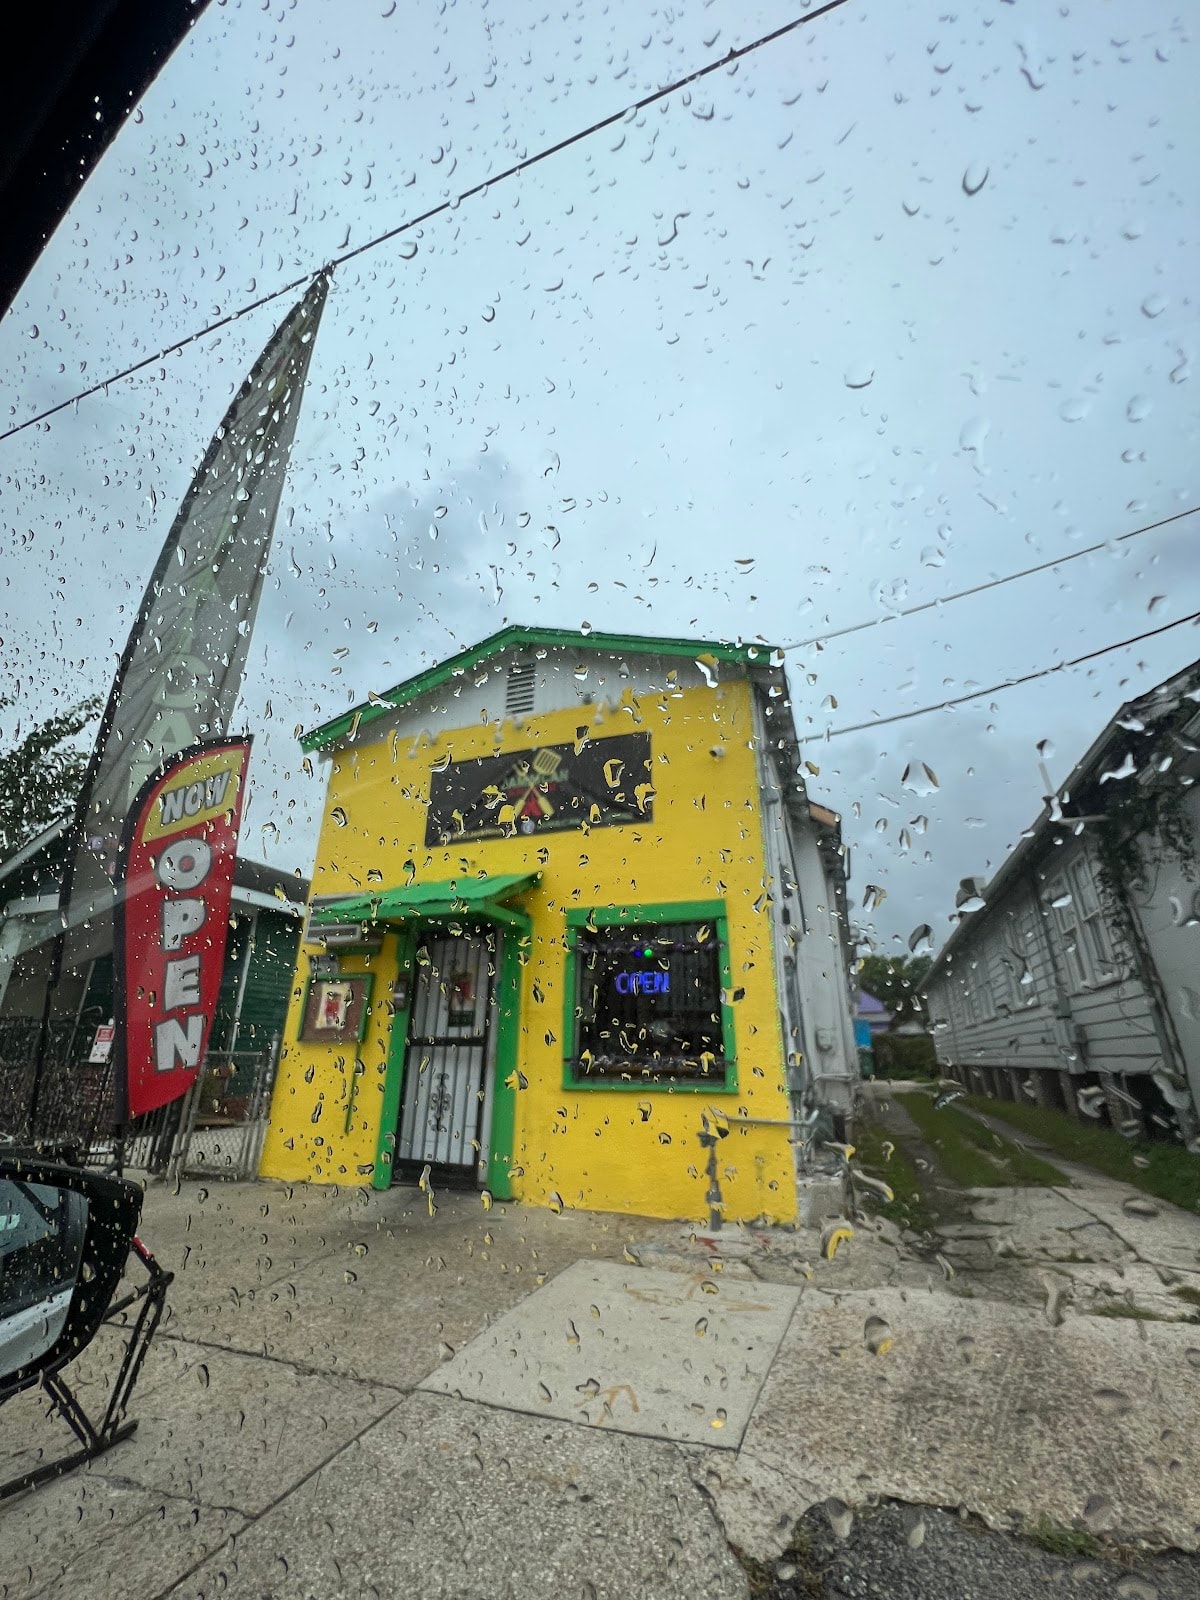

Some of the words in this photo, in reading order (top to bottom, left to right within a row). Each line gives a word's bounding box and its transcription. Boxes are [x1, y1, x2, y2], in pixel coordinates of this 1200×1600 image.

[160, 768, 232, 826] NOW
[153, 837, 212, 1072] OPEN
[615, 972, 670, 994] OPEN
